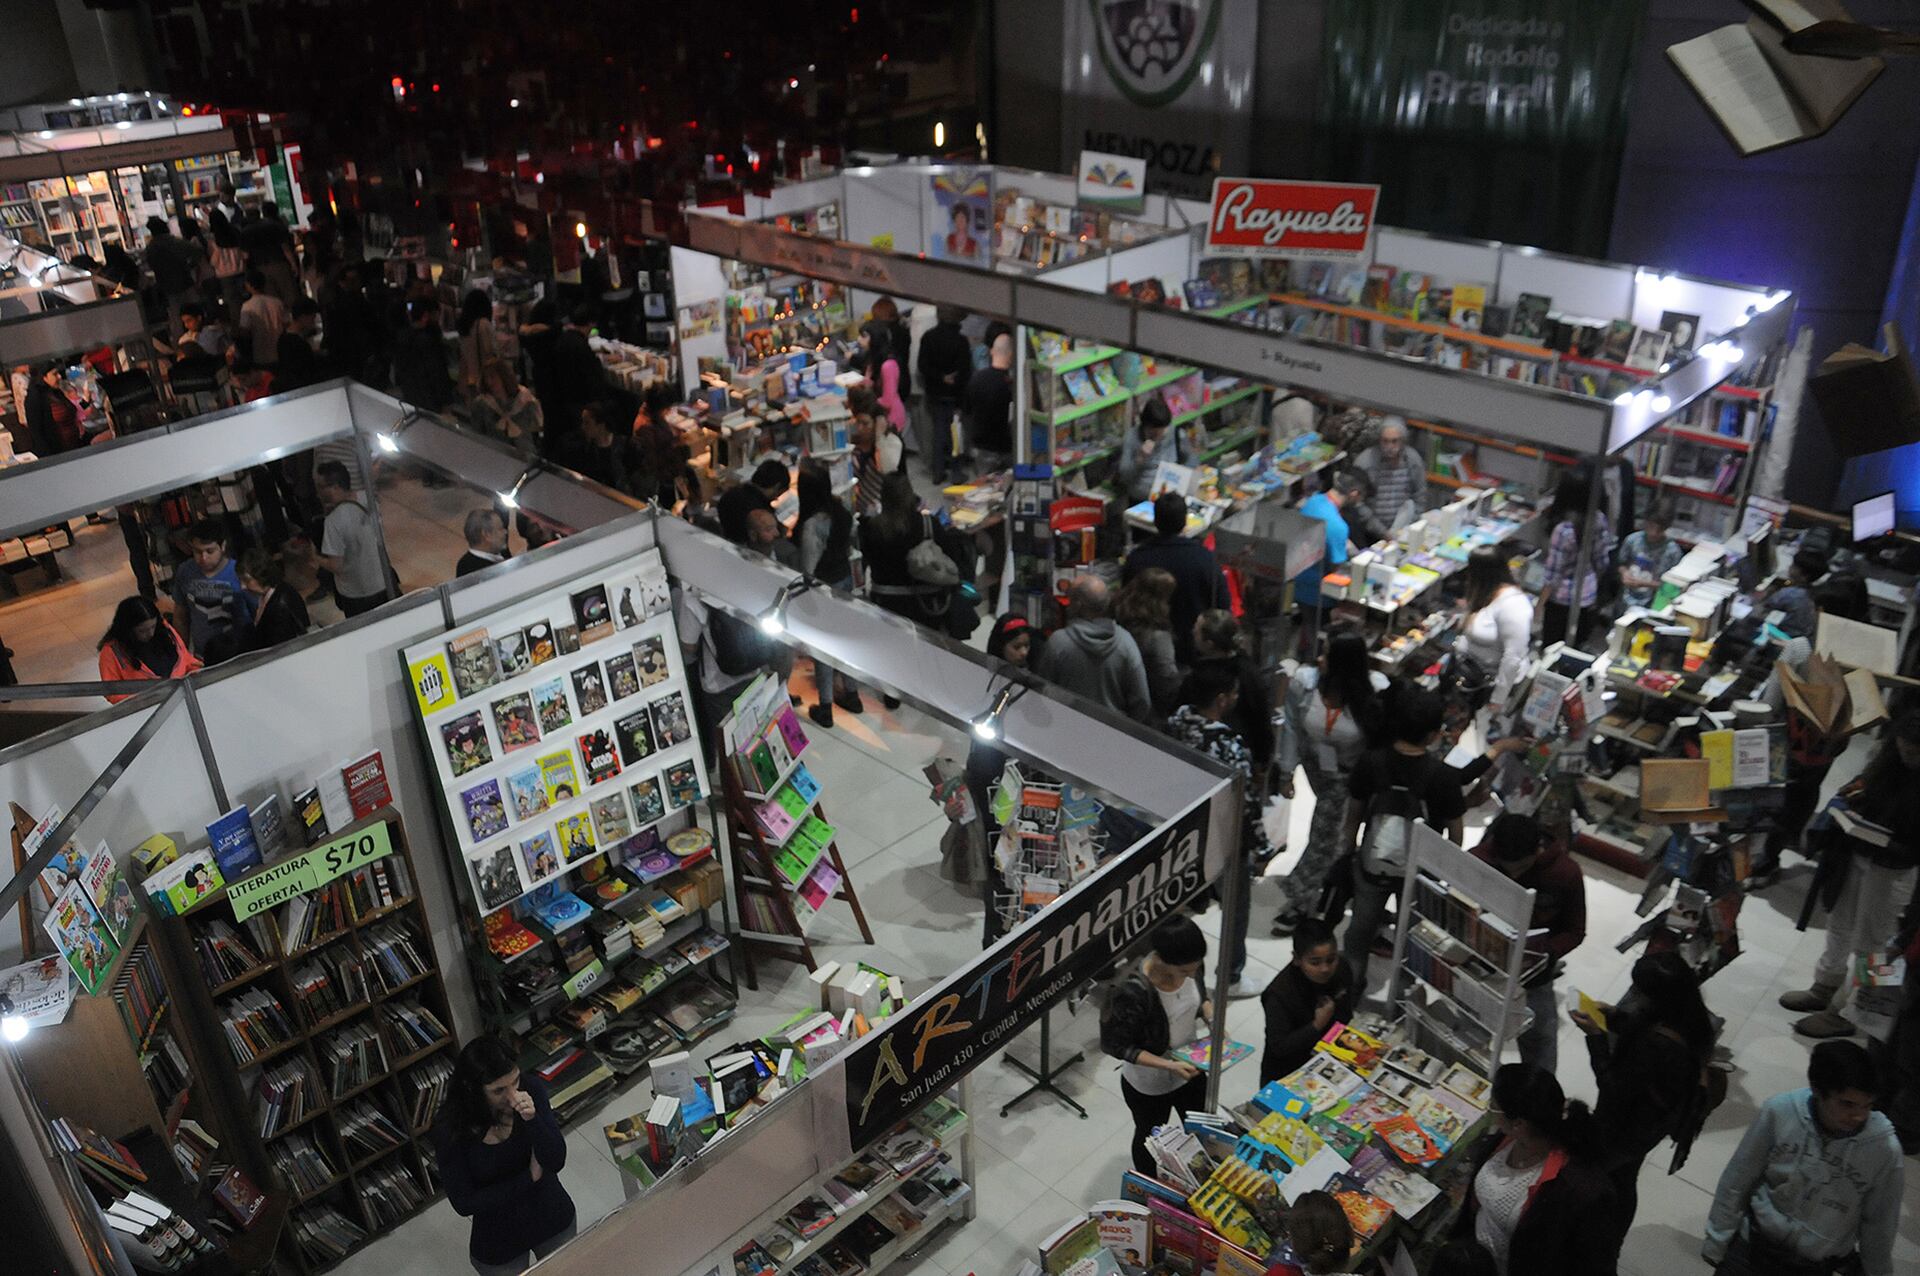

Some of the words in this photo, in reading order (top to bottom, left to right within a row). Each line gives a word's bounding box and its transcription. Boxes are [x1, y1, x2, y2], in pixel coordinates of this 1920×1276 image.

[1466, 43, 1560, 68] Rodolfo
[1085, 130, 1215, 176] MENDOZA
[1215, 184, 1366, 245] Rayuela
[325, 835, 374, 874] $70
[229, 856, 310, 900] LITERATURA
[247, 880, 304, 913] OFERTA!
[1108, 863, 1199, 953] LIBROS
[900, 1085, 923, 1107] San
[924, 1063, 951, 1093] Juan
[953, 1043, 974, 1067] 430
[981, 1009, 1019, 1046] Capital
[1026, 971, 1073, 1012] Mendoza
